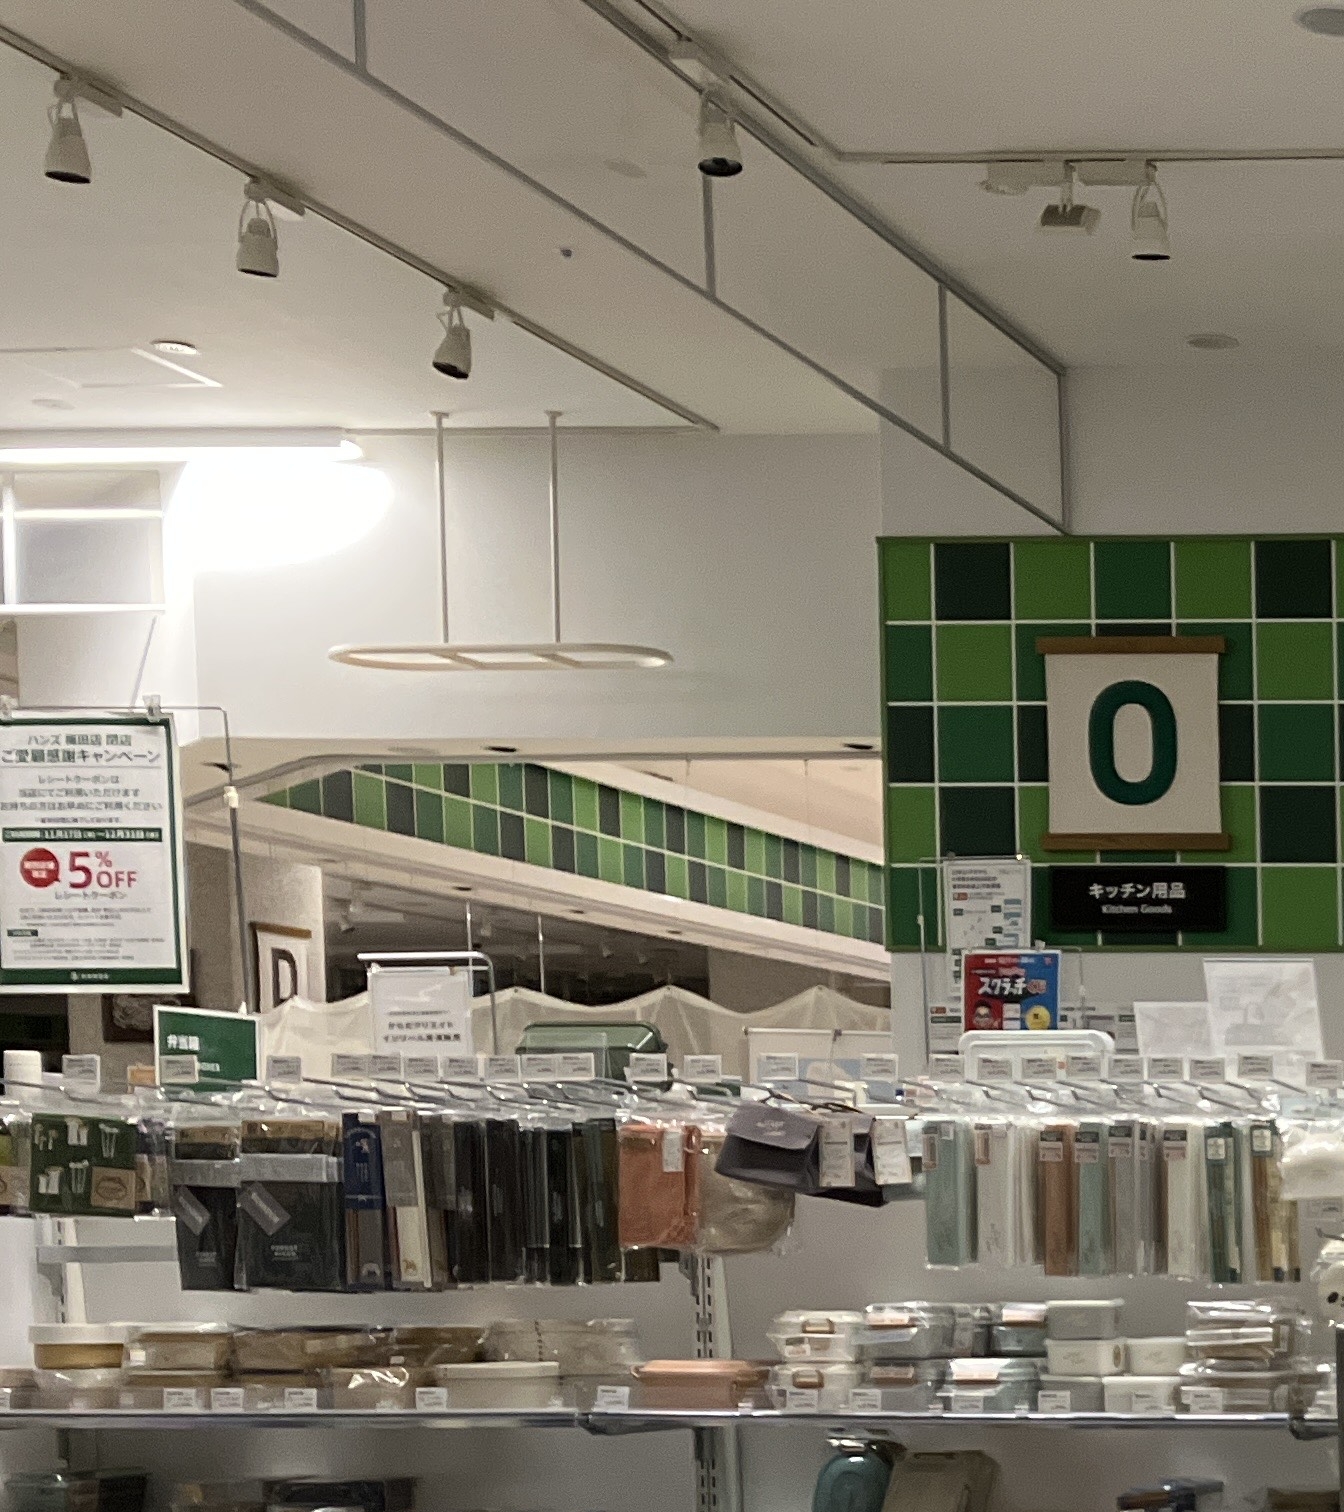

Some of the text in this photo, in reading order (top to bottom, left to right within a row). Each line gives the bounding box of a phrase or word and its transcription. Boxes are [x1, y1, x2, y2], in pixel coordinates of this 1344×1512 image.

[28, 734, 61, 745] ハンズ
[69, 851, 92, 889] 5
[96, 871, 138, 888] OFF
[1089, 882, 1186, 899] キッチン用品
[1102, 903, 1172, 914] Kitchen Goods
[271, 946, 299, 1007] D
